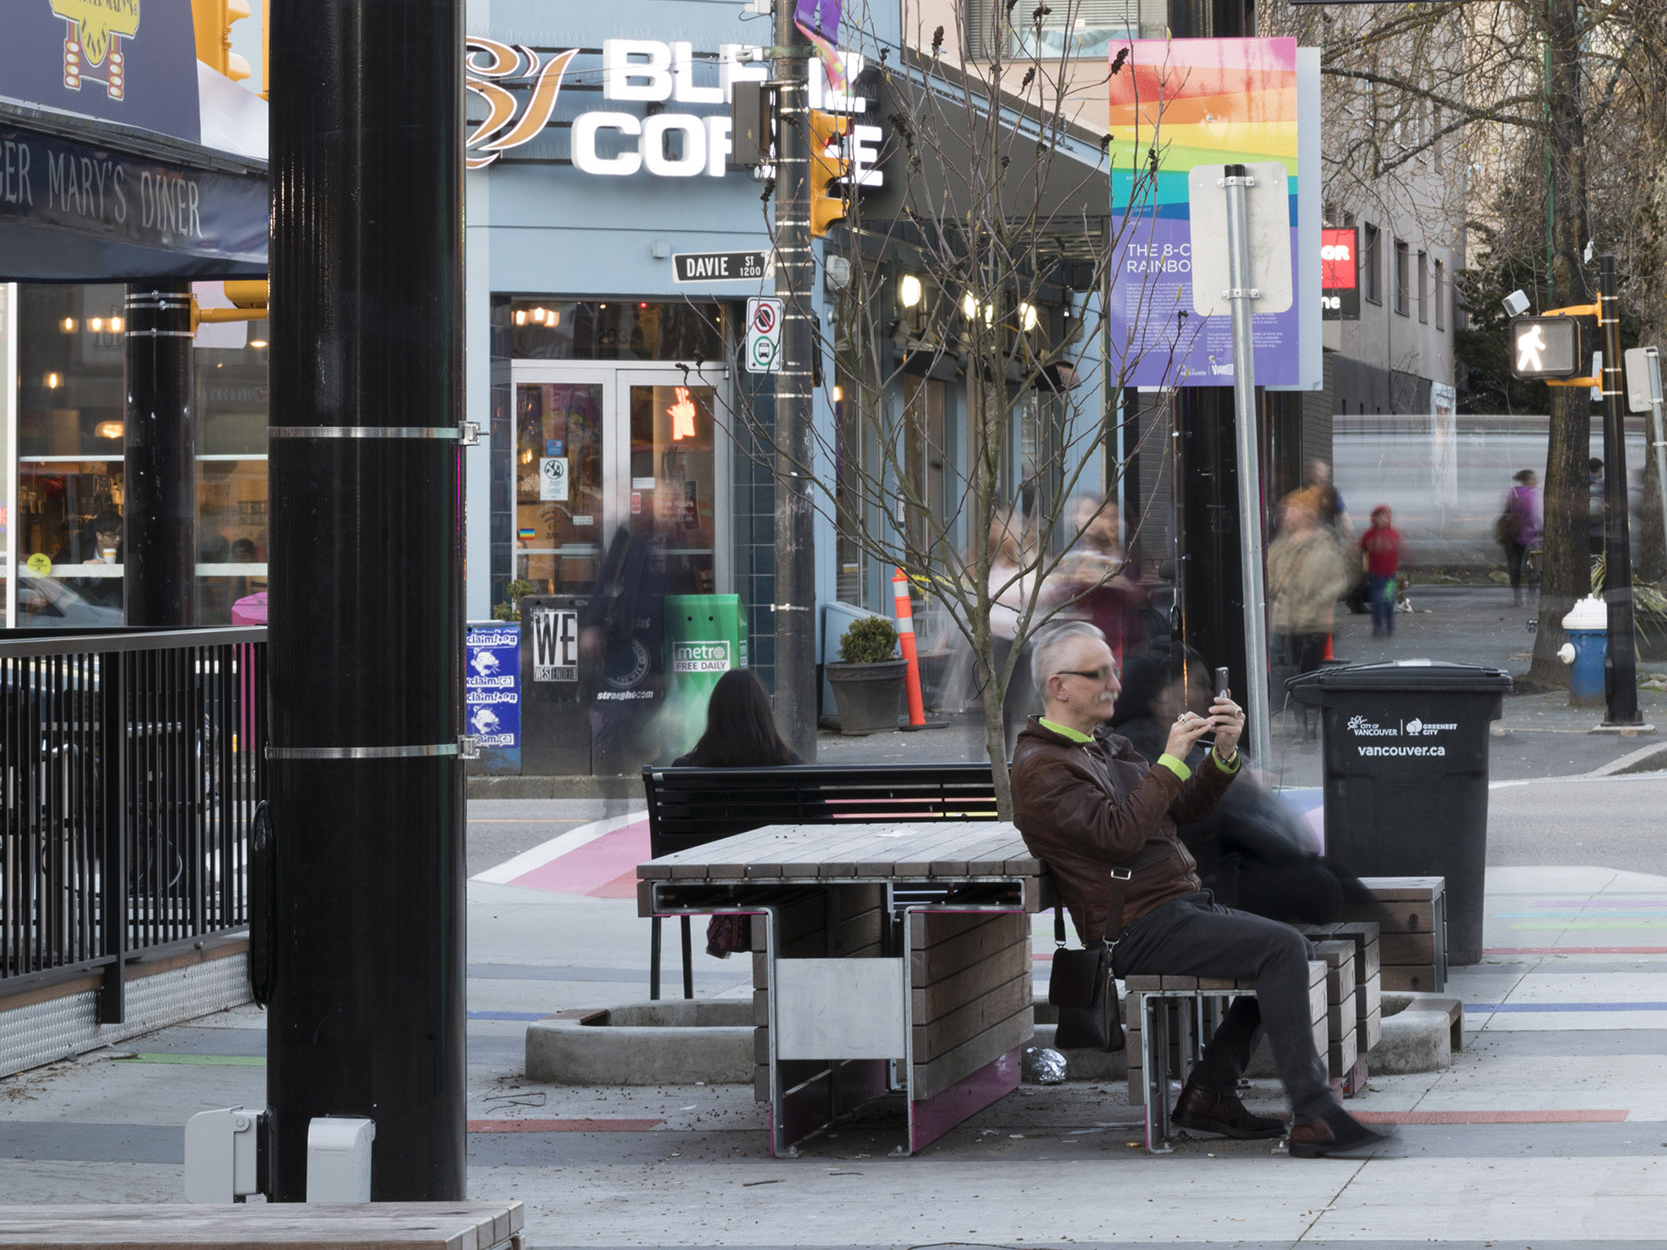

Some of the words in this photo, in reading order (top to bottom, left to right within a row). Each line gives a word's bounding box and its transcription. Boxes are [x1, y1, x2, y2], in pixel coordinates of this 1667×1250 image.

[81, 16, 108, 58] DINER
[0, 140, 33, 207] ER
[48, 149, 127, 225] MARY'S
[140, 170, 204, 239] DINER
[1127, 243, 1159, 257] THE
[1163, 243, 1191, 257] 8-C
[686, 256, 729, 278] DAVIE
[745, 255, 755, 266] ST
[740, 267, 761, 277] 1200
[1127, 259, 1191, 273] RAINBO
[1321, 296, 1341, 309] ne
[534, 612, 577, 666] WE
[678, 645, 725, 659] metro
[676, 661, 698, 670] FREE
[701, 661, 726, 670] DAILY
[1358, 746, 1445, 756] vancouver.ca
